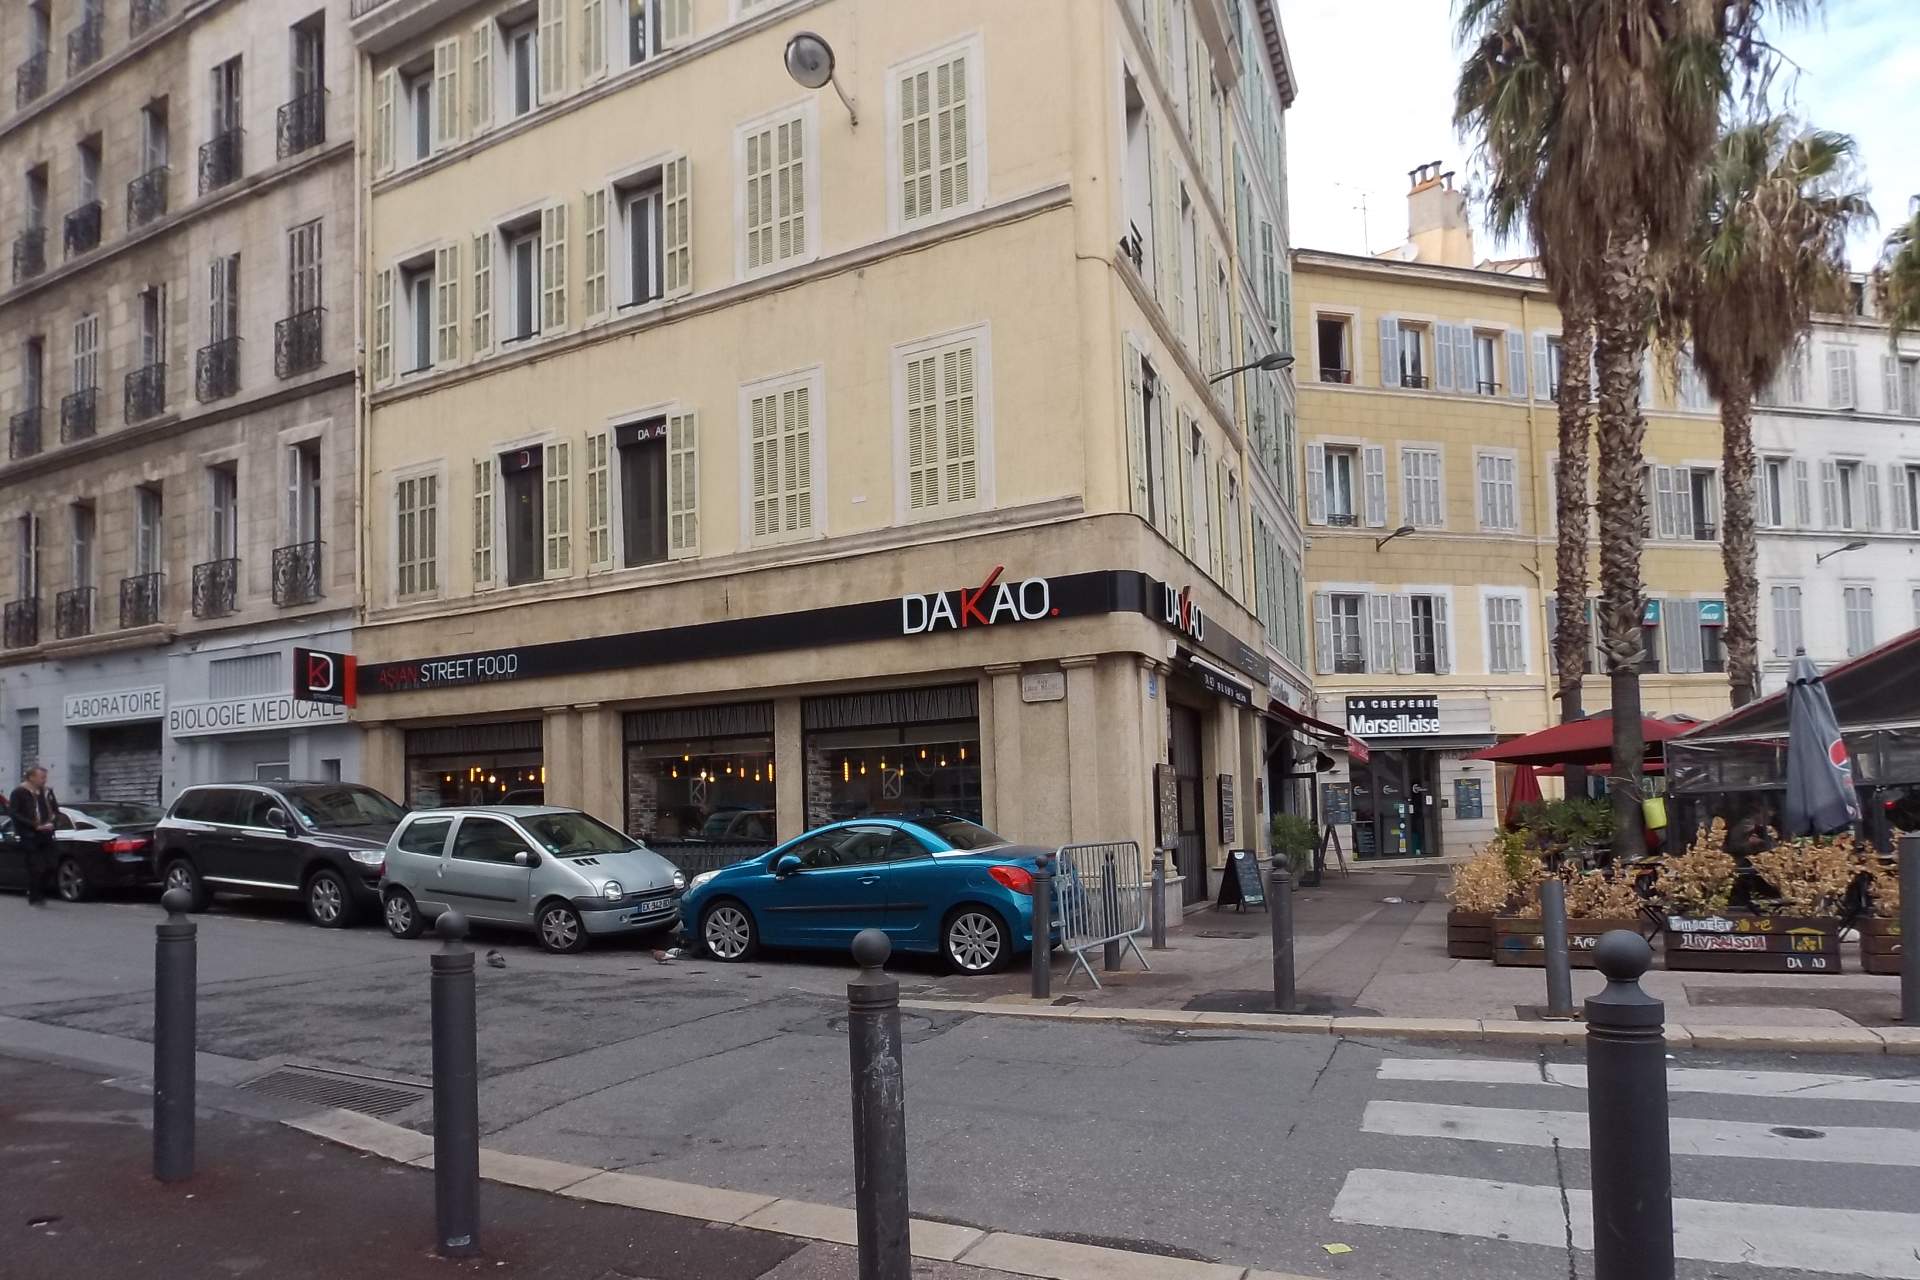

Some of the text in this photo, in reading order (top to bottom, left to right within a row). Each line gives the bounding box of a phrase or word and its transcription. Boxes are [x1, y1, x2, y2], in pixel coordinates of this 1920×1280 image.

[1164, 581, 1205, 642] DAKAO
[420, 658, 474, 682] STREET
[477, 653, 518, 677] FOOD
[64, 691, 161, 719] LABORATOIRE
[170, 703, 247, 730] BIOLOGIE
[1349, 699, 1440, 709] LA CREPERIE
[1349, 714, 1441, 734] Marseillaise
